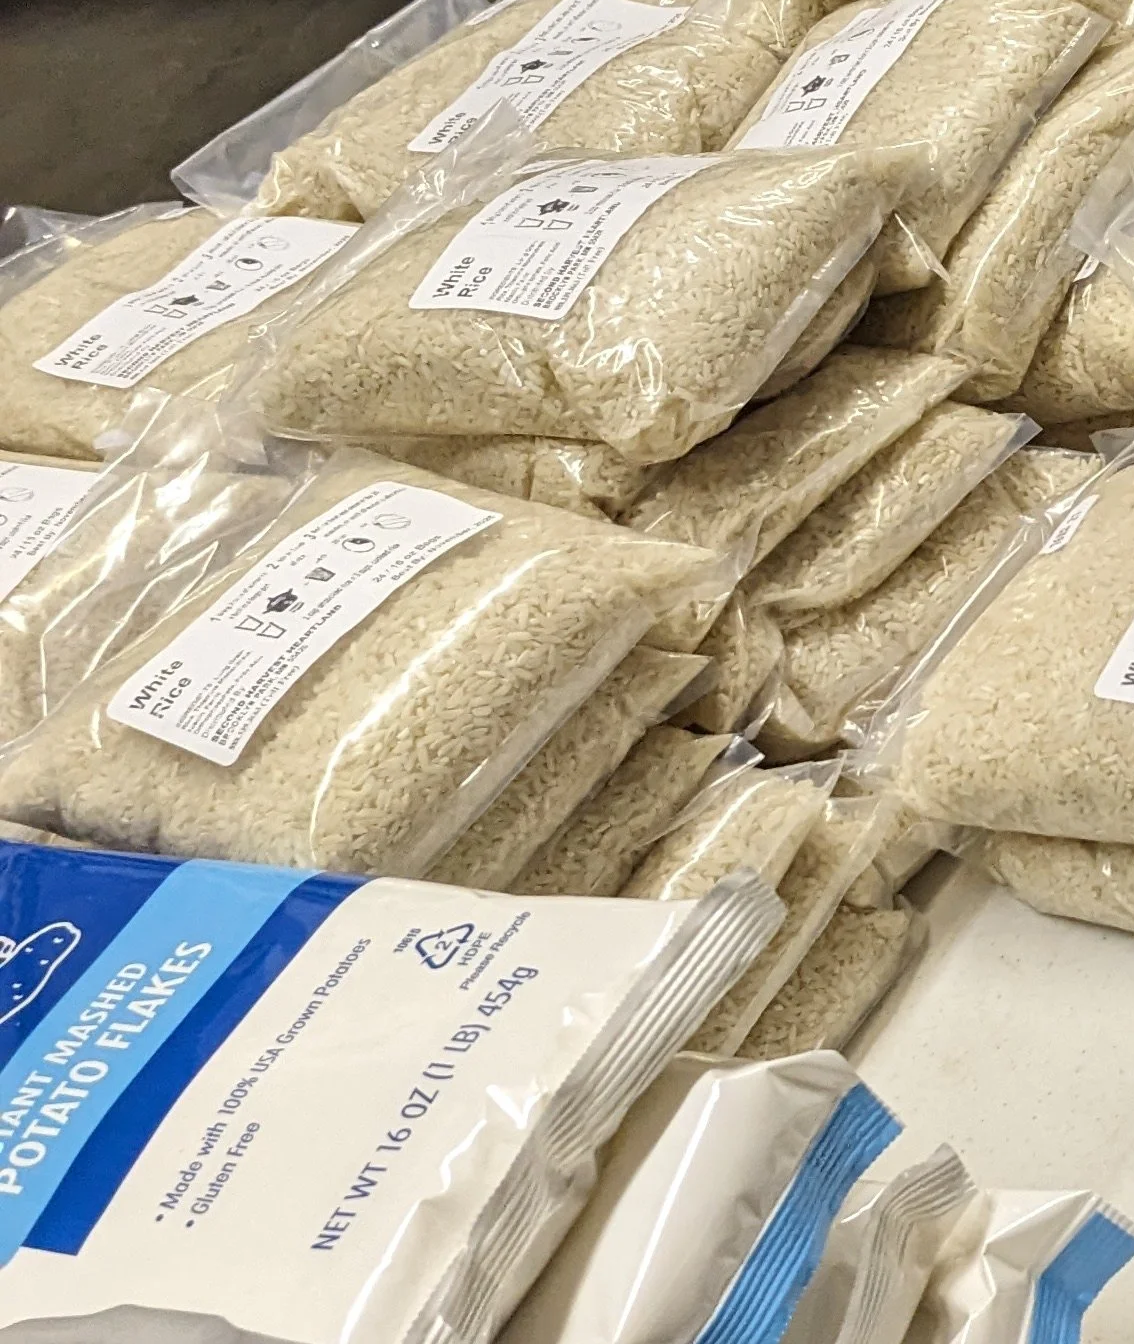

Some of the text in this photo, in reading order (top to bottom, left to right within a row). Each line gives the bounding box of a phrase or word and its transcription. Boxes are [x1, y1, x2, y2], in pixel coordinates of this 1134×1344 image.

[429, 112, 467, 145] White
[433, 256, 475, 298] White
[457, 266, 493, 298] Rice
[532, 276, 561, 308] SECOND
[54, 334, 102, 366] White
[71, 344, 108, 370] Rice
[414, 535, 442, 553] Bags
[390, 564, 413, 581] Best
[129, 660, 183, 710] White
[209, 604, 342, 743] SECOND HARVEST HEARTLAND
[151, 677, 192, 719] Rice
[213, 700, 261, 746] BROOKLYN
[457, 932, 492, 966] HDPE
[459, 911, 531, 991] Please Recycle
[44, 962, 147, 1064] MASHED
[0, 941, 212, 1196] POTATO FLAKES
[160, 938, 371, 1210] Made with 100% USA Grown Potatoes
[311, 966, 538, 1251] NET WT 16 OZ (1 LB) 454g
[190, 1122, 261, 1215] Gluten Free
